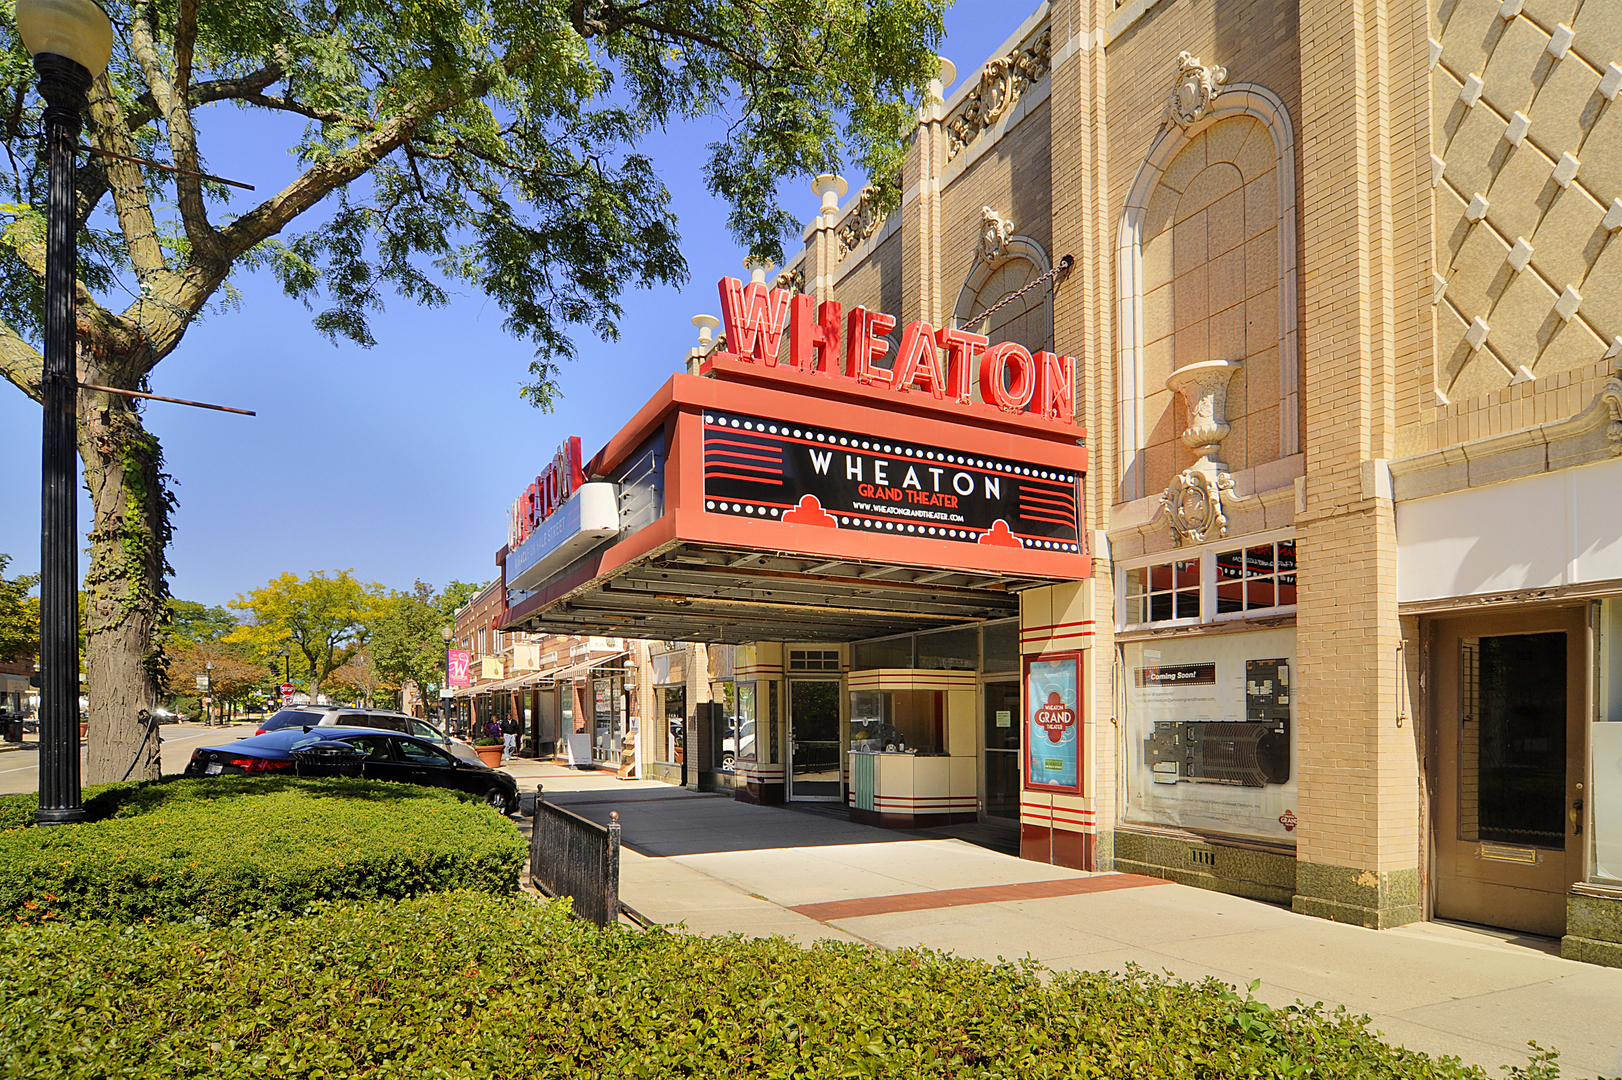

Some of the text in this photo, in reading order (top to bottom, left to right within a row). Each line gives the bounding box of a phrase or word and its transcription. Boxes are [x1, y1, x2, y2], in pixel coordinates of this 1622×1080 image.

[718, 276, 1077, 425] WHEATON
[809, 449, 1001, 500] WHEATON
[858, 483, 958, 509] GRAND THEATER
[853, 501, 965, 522] WWW.WHEATONGRANDTHEATER.COM
[548, 516, 566, 542] STREET
[1177, 671, 1197, 679] Soon!
[1038, 711, 1072, 724] GRAND
